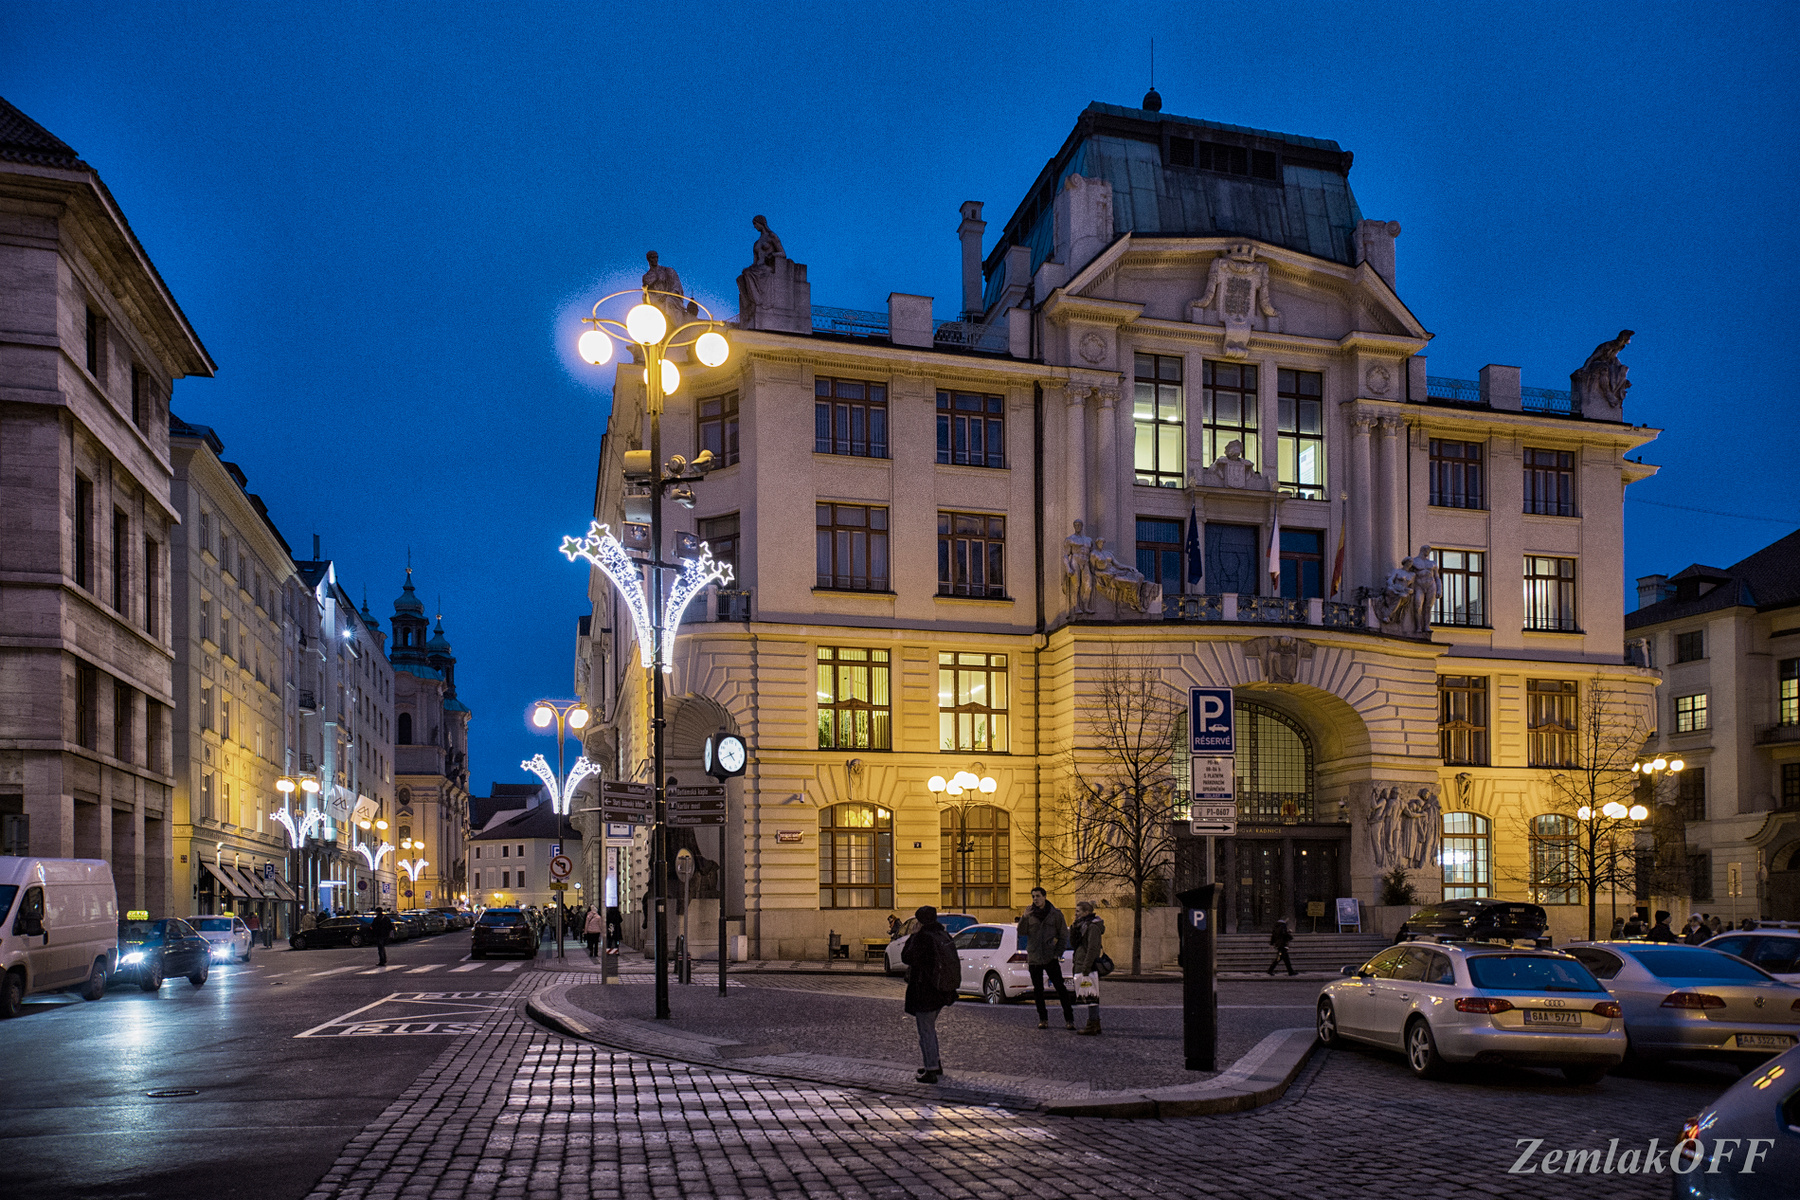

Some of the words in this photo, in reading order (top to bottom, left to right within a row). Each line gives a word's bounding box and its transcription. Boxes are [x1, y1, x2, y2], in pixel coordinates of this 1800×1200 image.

[1199, 695, 1224, 733] P
[1194, 737, 1231, 745] RÉSERVÉ
[1206, 808, 1230, 816] P1-0607
[1193, 910, 1205, 927] P
[1532, 1012, 1549, 1022] 6AA
[1554, 1012, 1577, 1023] 5771
[339, 1024, 484, 1035] BUS
[1743, 1036, 1755, 1045] AA
